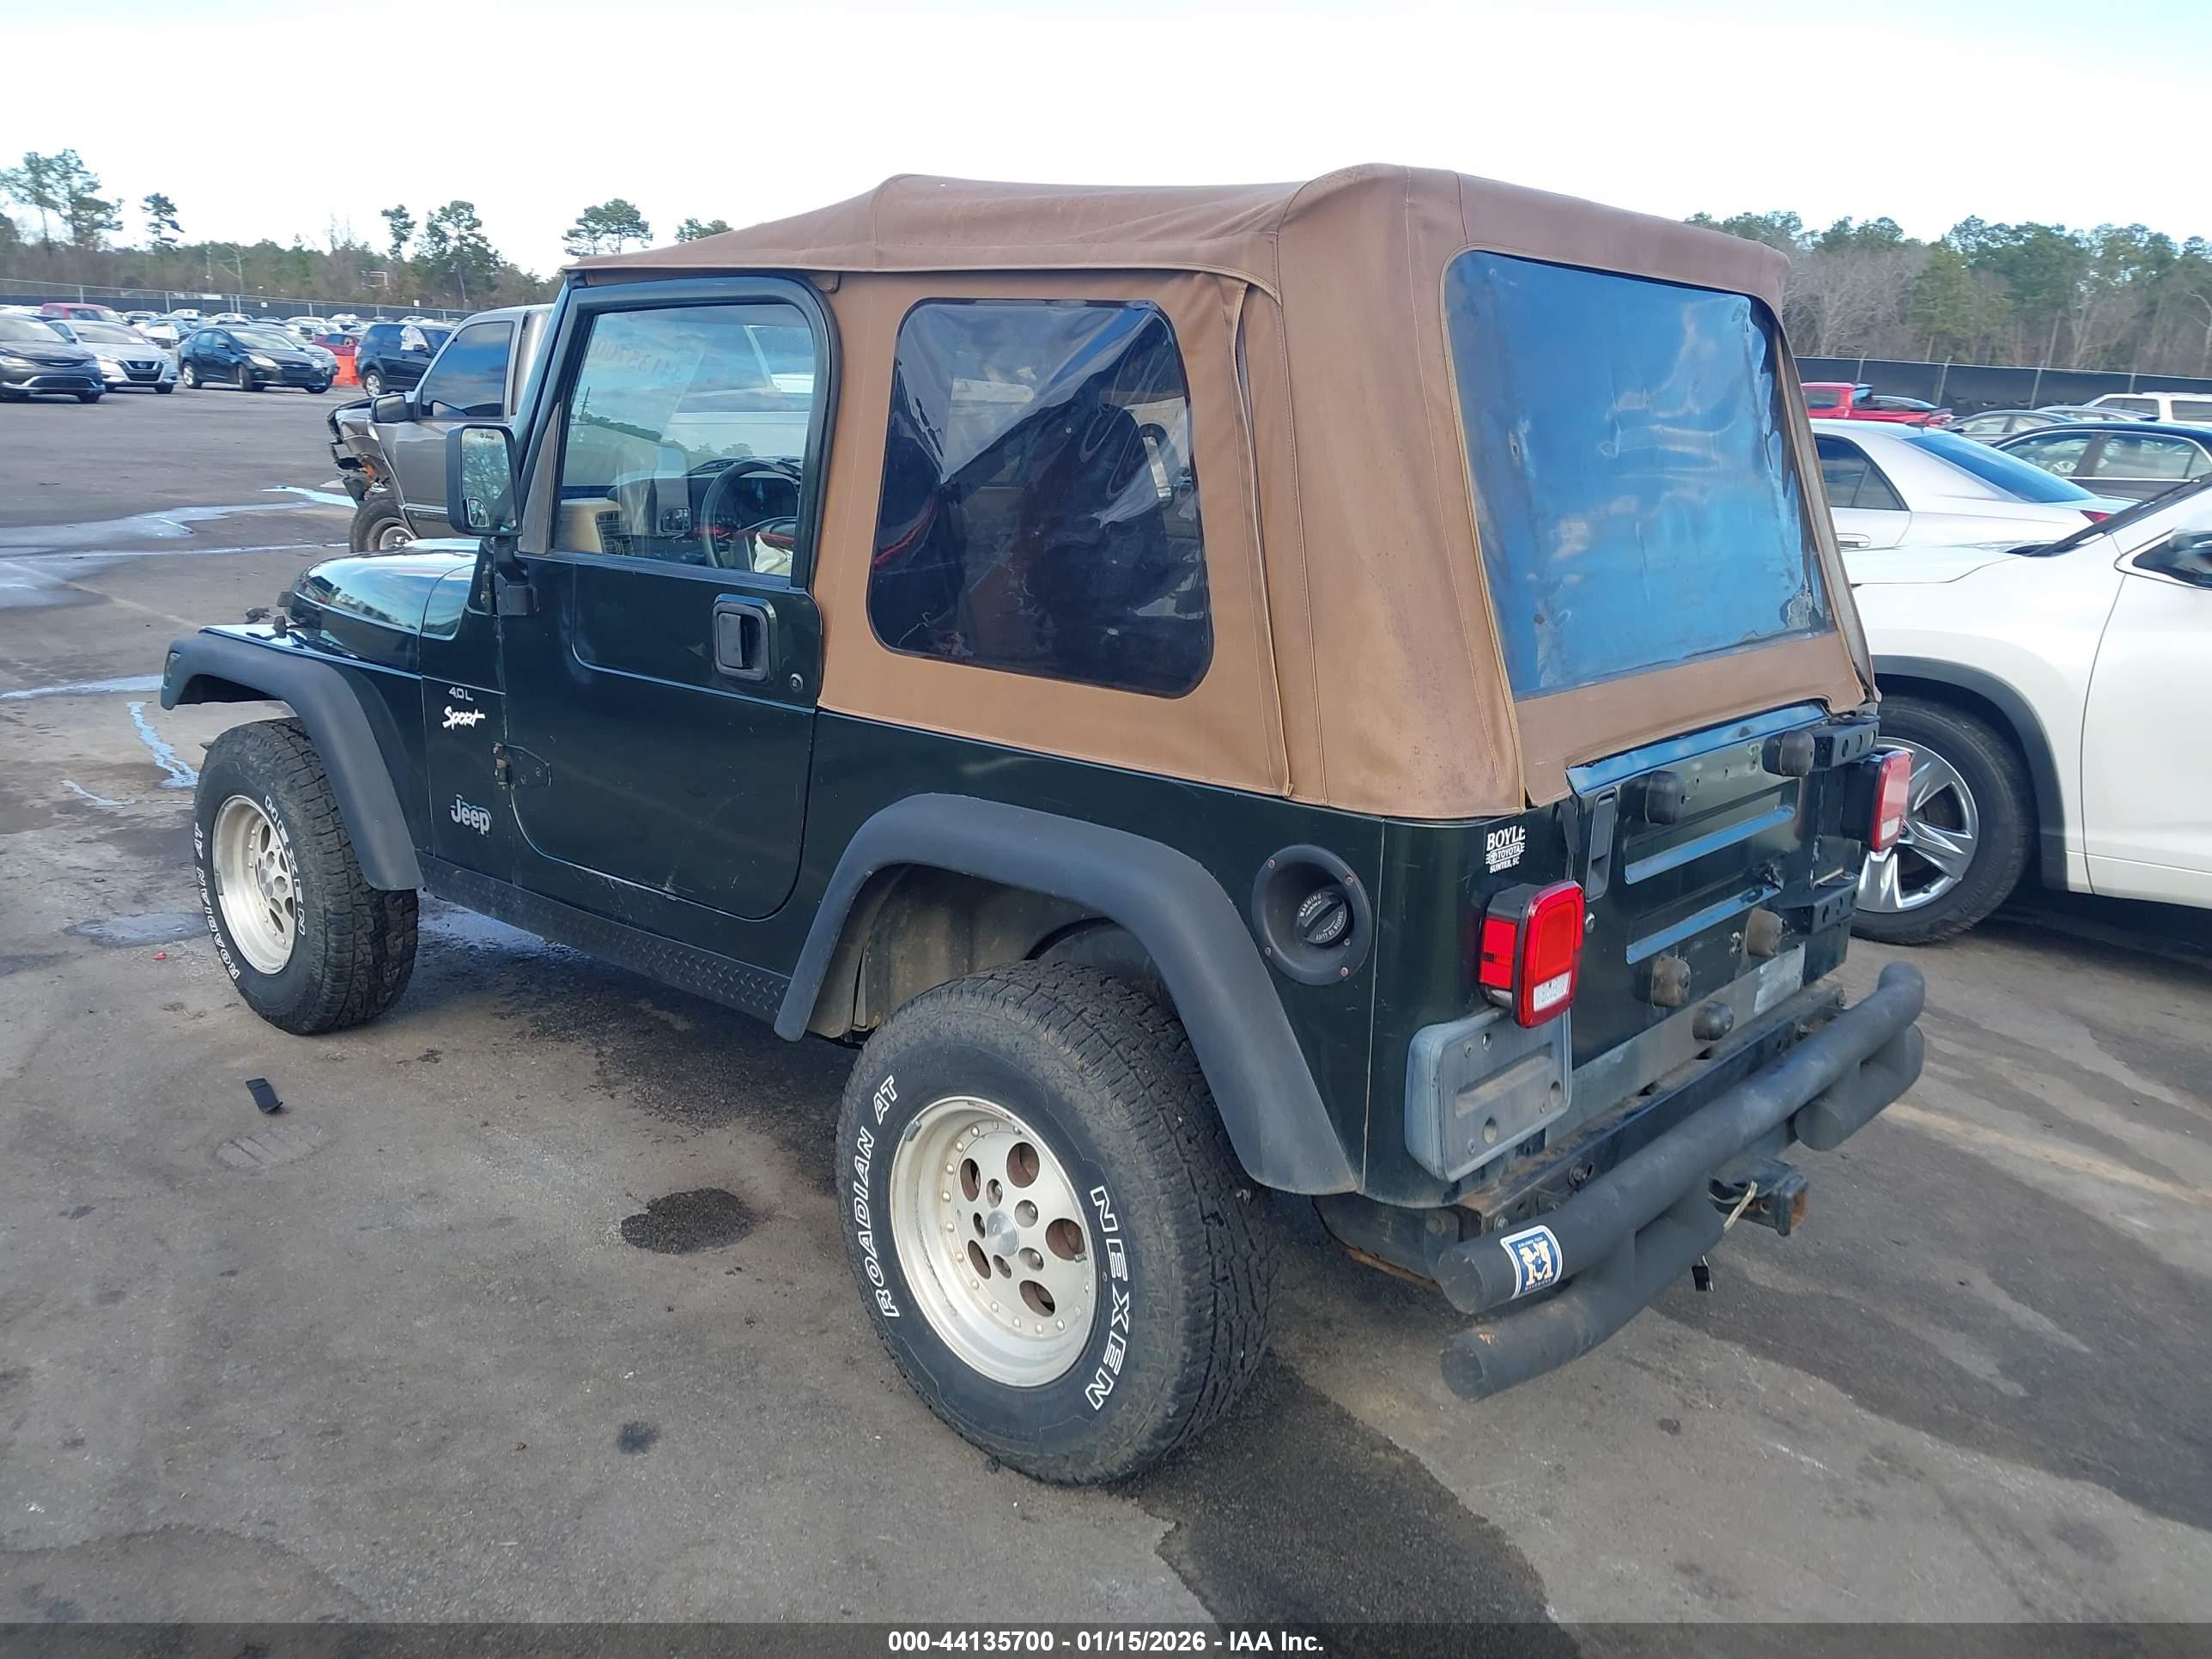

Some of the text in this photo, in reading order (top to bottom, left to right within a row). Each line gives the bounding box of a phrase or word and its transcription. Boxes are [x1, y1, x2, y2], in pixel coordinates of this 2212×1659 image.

[442, 706, 486, 730] Sport
[450, 798, 491, 836] Jeep
[1486, 825, 1526, 851] BOYLE
[1498, 844, 1521, 860] TOYOTA
[264, 795, 306, 937] NEXEN
[194, 822, 240, 980] ROADIAN AT
[1299, 893, 1322, 917] WARNING
[854, 1075, 900, 1317] ROADIAN AT
[1085, 1186, 1130, 1411] NEXEN
